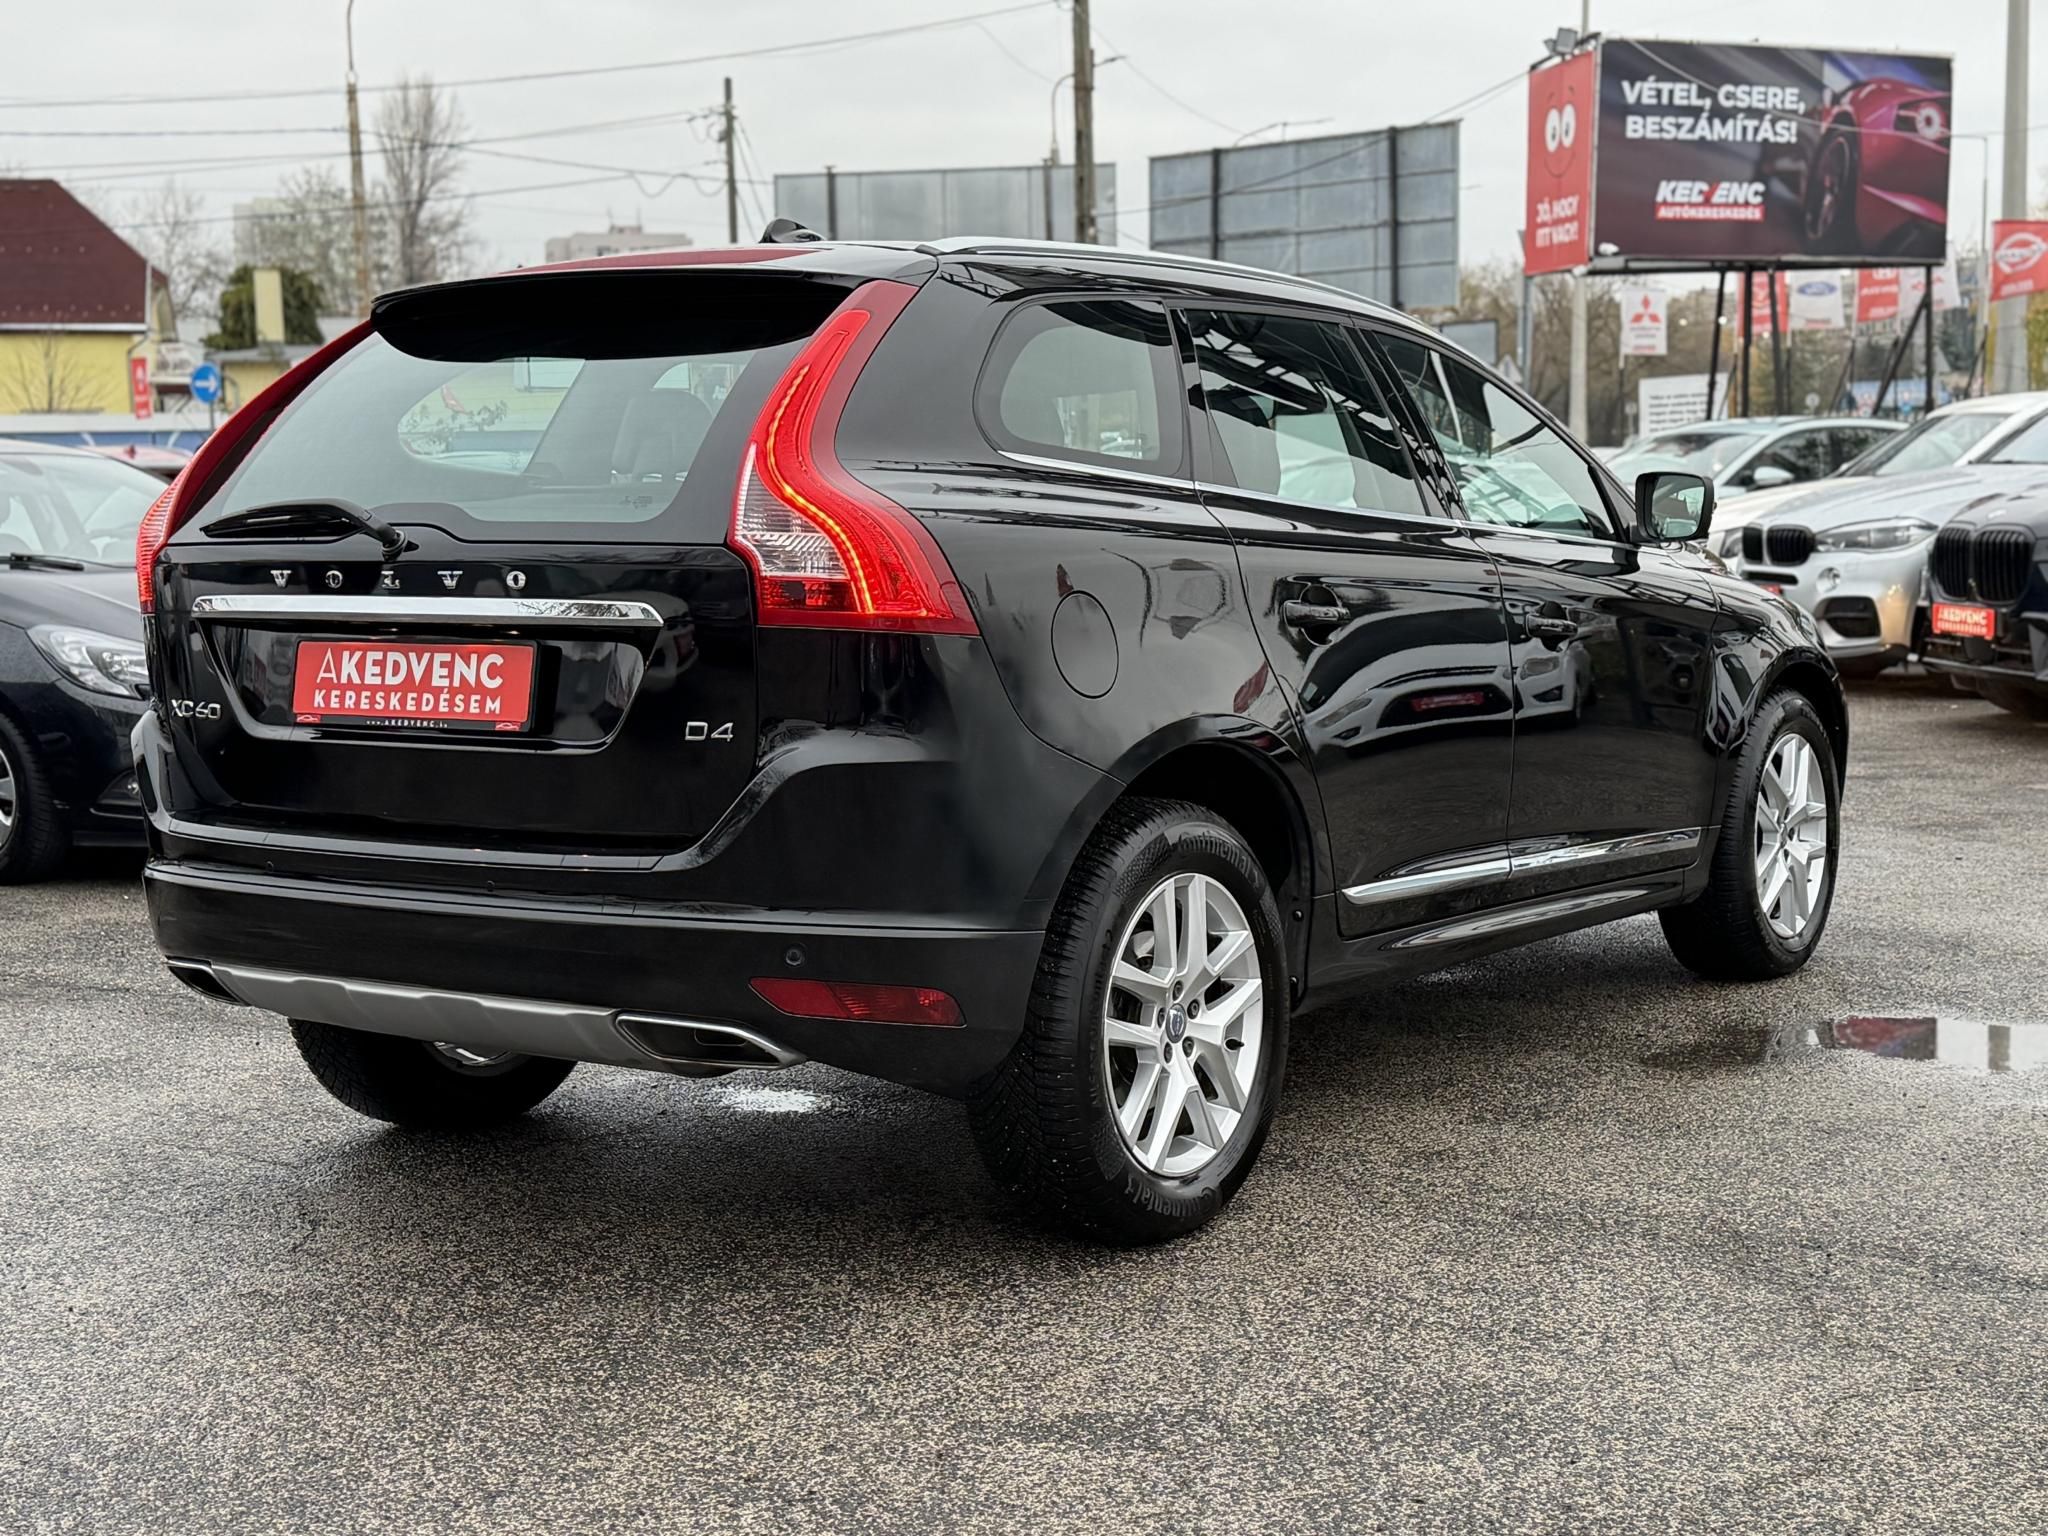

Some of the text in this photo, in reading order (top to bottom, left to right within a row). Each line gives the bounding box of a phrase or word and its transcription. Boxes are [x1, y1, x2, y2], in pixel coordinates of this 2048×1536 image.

[1620, 75, 1806, 114] VÉTEL, CSERE,
[1625, 112, 1798, 143] BESZÁMÍTÁS!
[270, 570, 527, 590] VOLVO
[171, 699, 221, 719] XC60
[313, 688, 501, 715] KERESKEDÉSEM
[685, 721, 734, 742] D4
